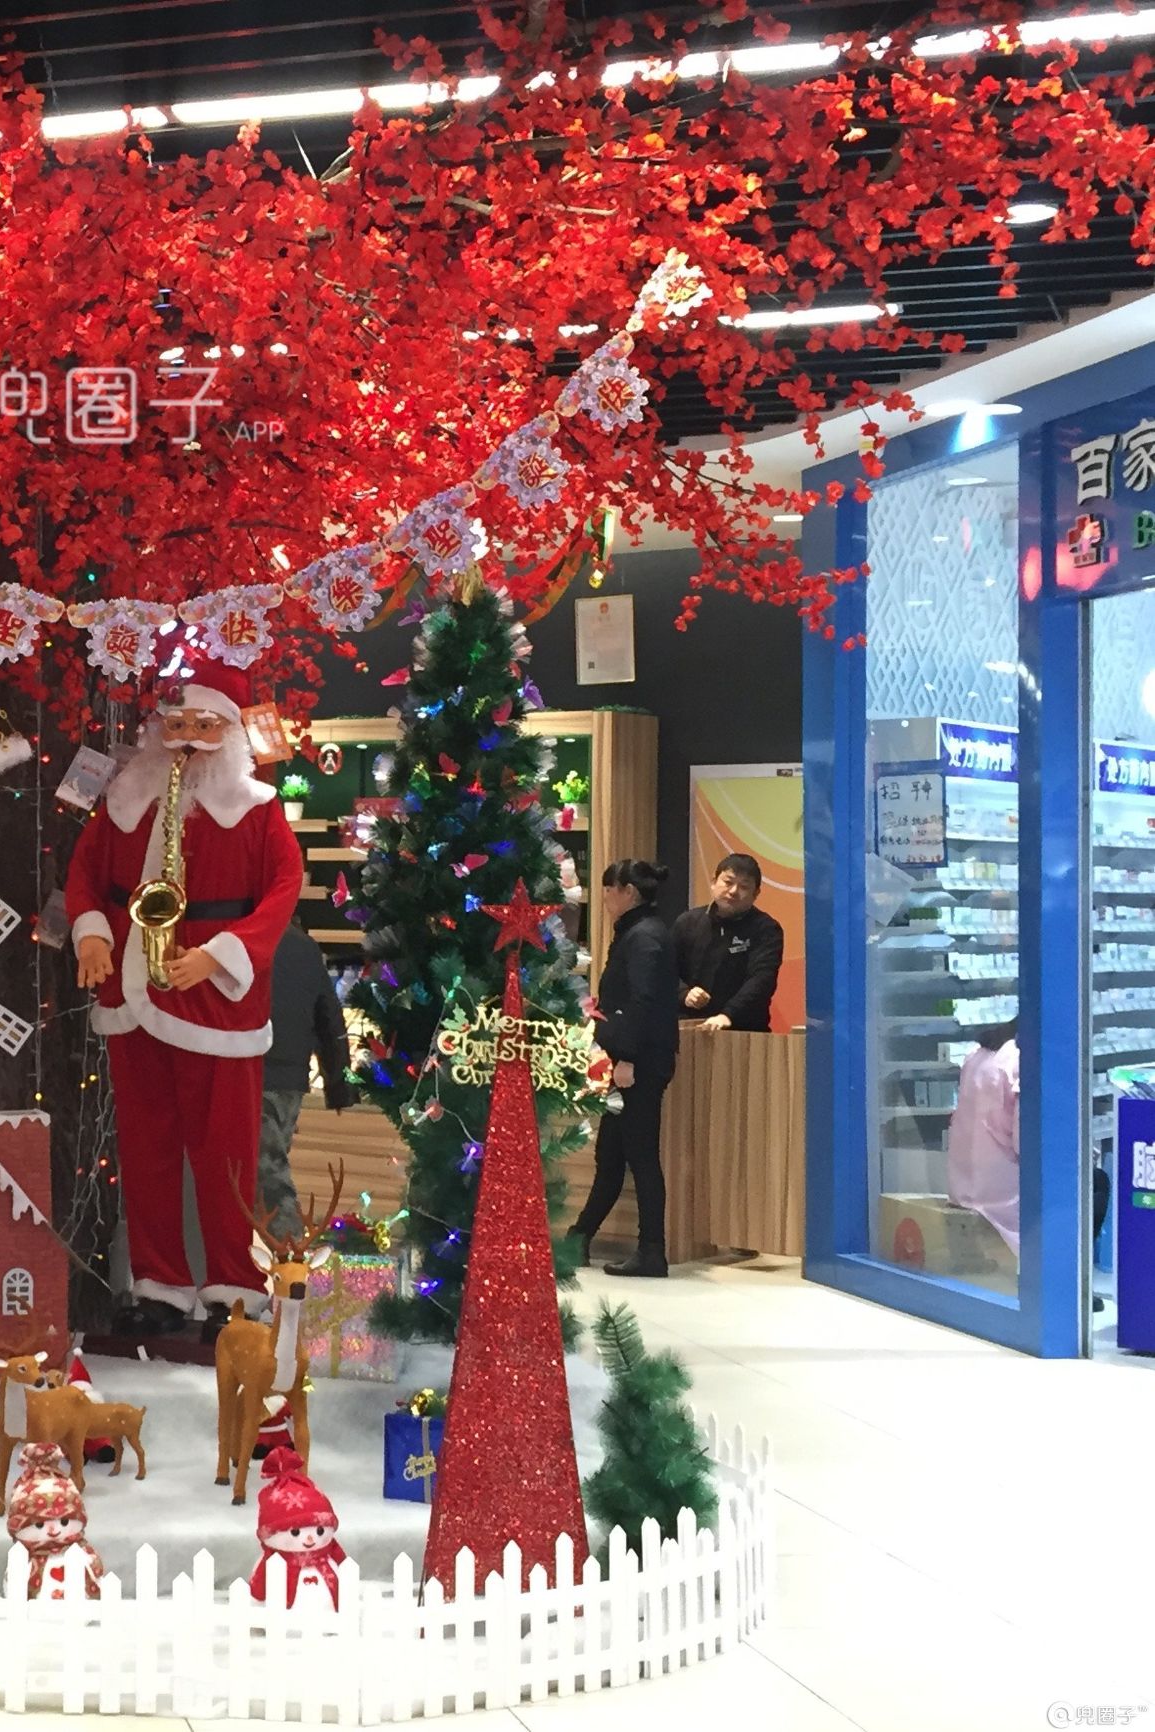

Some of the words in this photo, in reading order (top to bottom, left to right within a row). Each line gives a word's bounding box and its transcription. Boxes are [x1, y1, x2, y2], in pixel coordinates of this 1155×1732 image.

[1070, 418, 1155, 506] 百家
[105, 623, 141, 668] 誕
[219, 610, 258, 647] 快
[470, 1005, 567, 1046] Merry
[437, 1029, 590, 1075] Christmas
